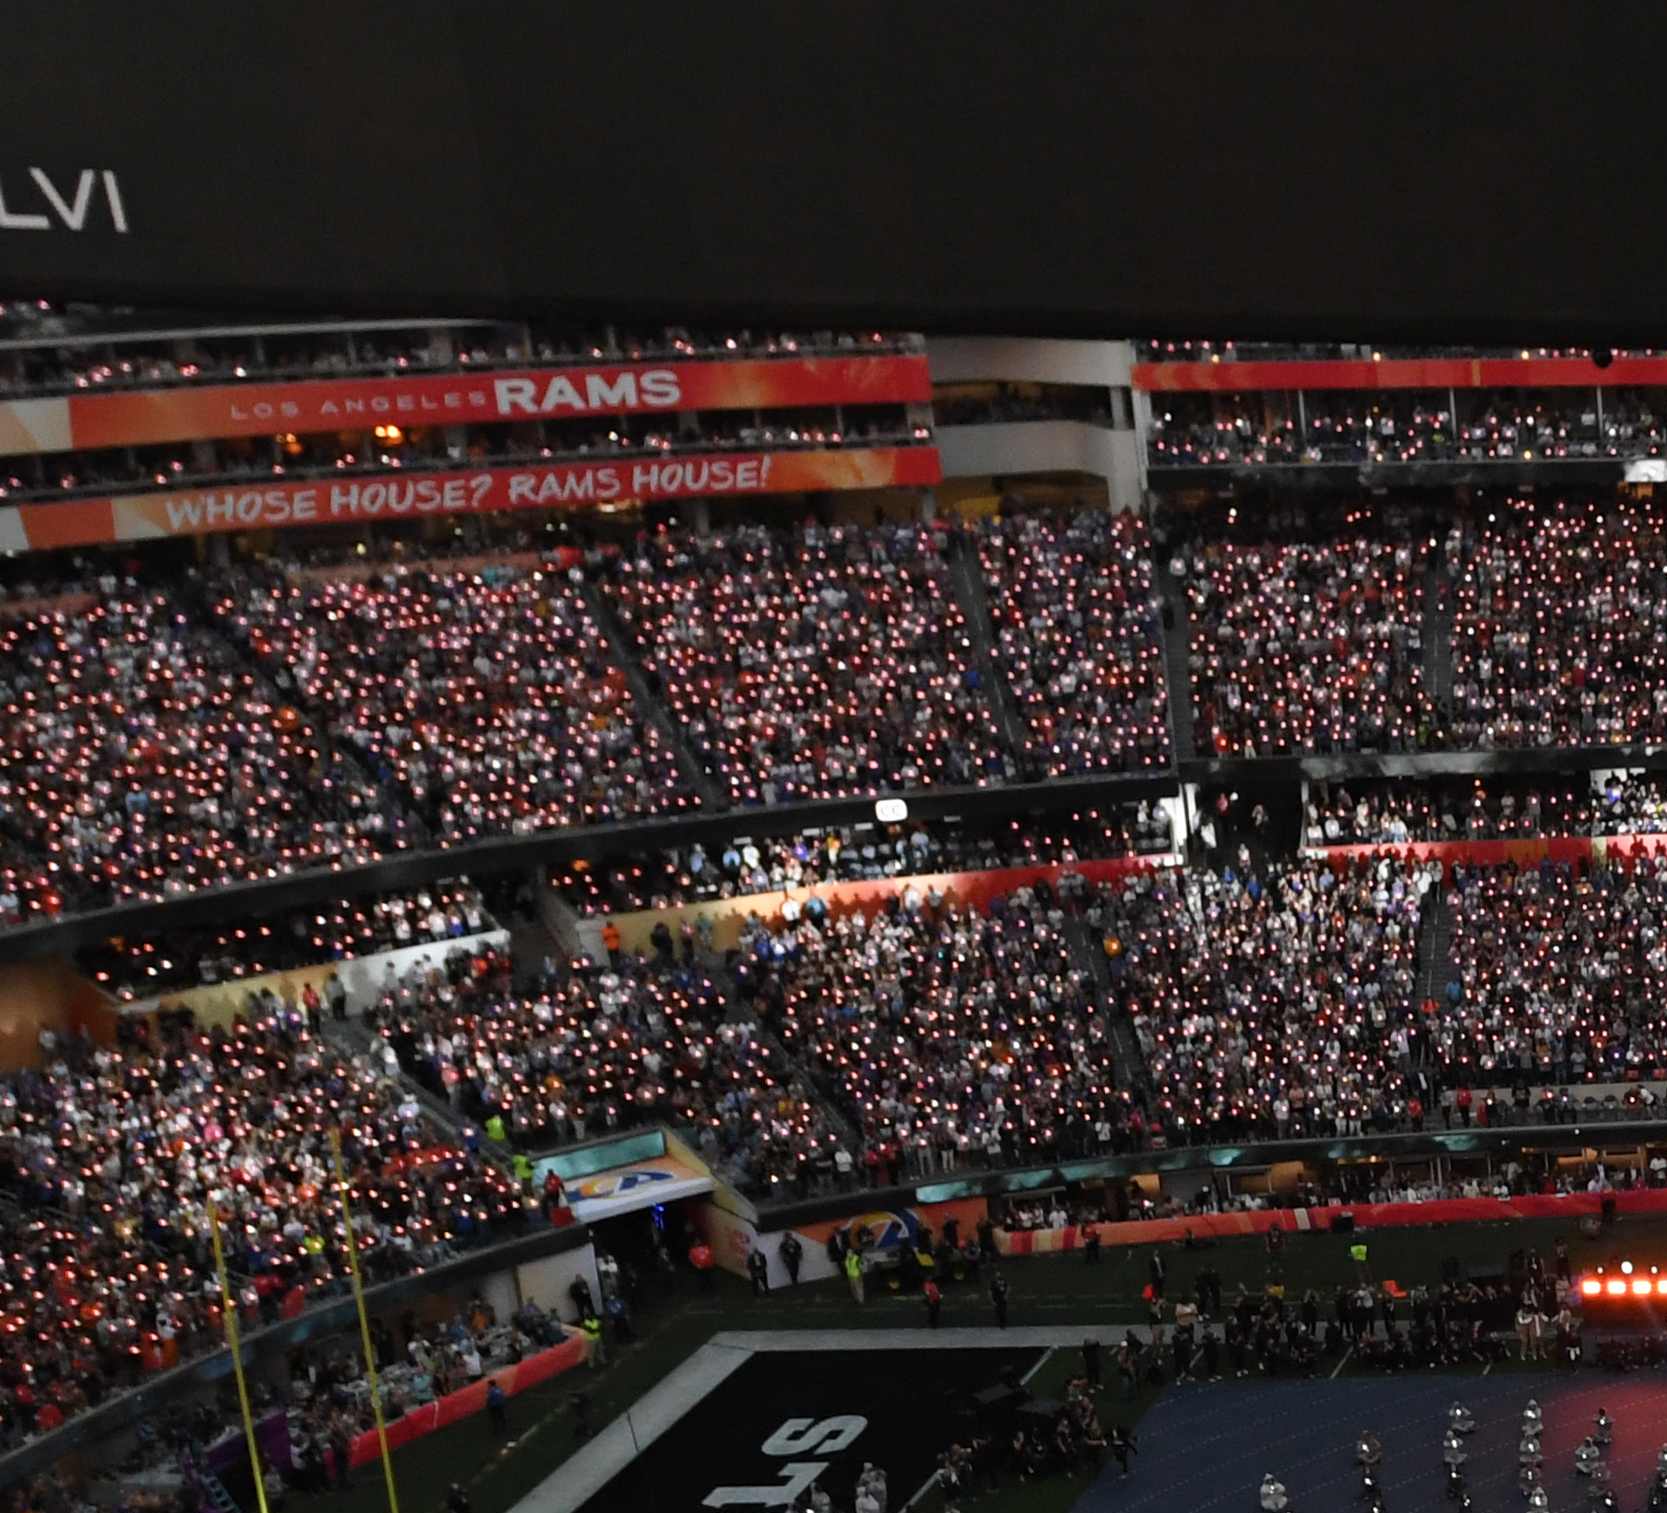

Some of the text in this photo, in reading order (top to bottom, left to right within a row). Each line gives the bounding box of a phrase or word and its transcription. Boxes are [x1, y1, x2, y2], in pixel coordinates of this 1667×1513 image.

[229, 368, 682, 421] LOS ANGELES RAMS
[165, 456, 773, 530] WHOSE HOUSE? RAMS HOUSE!
